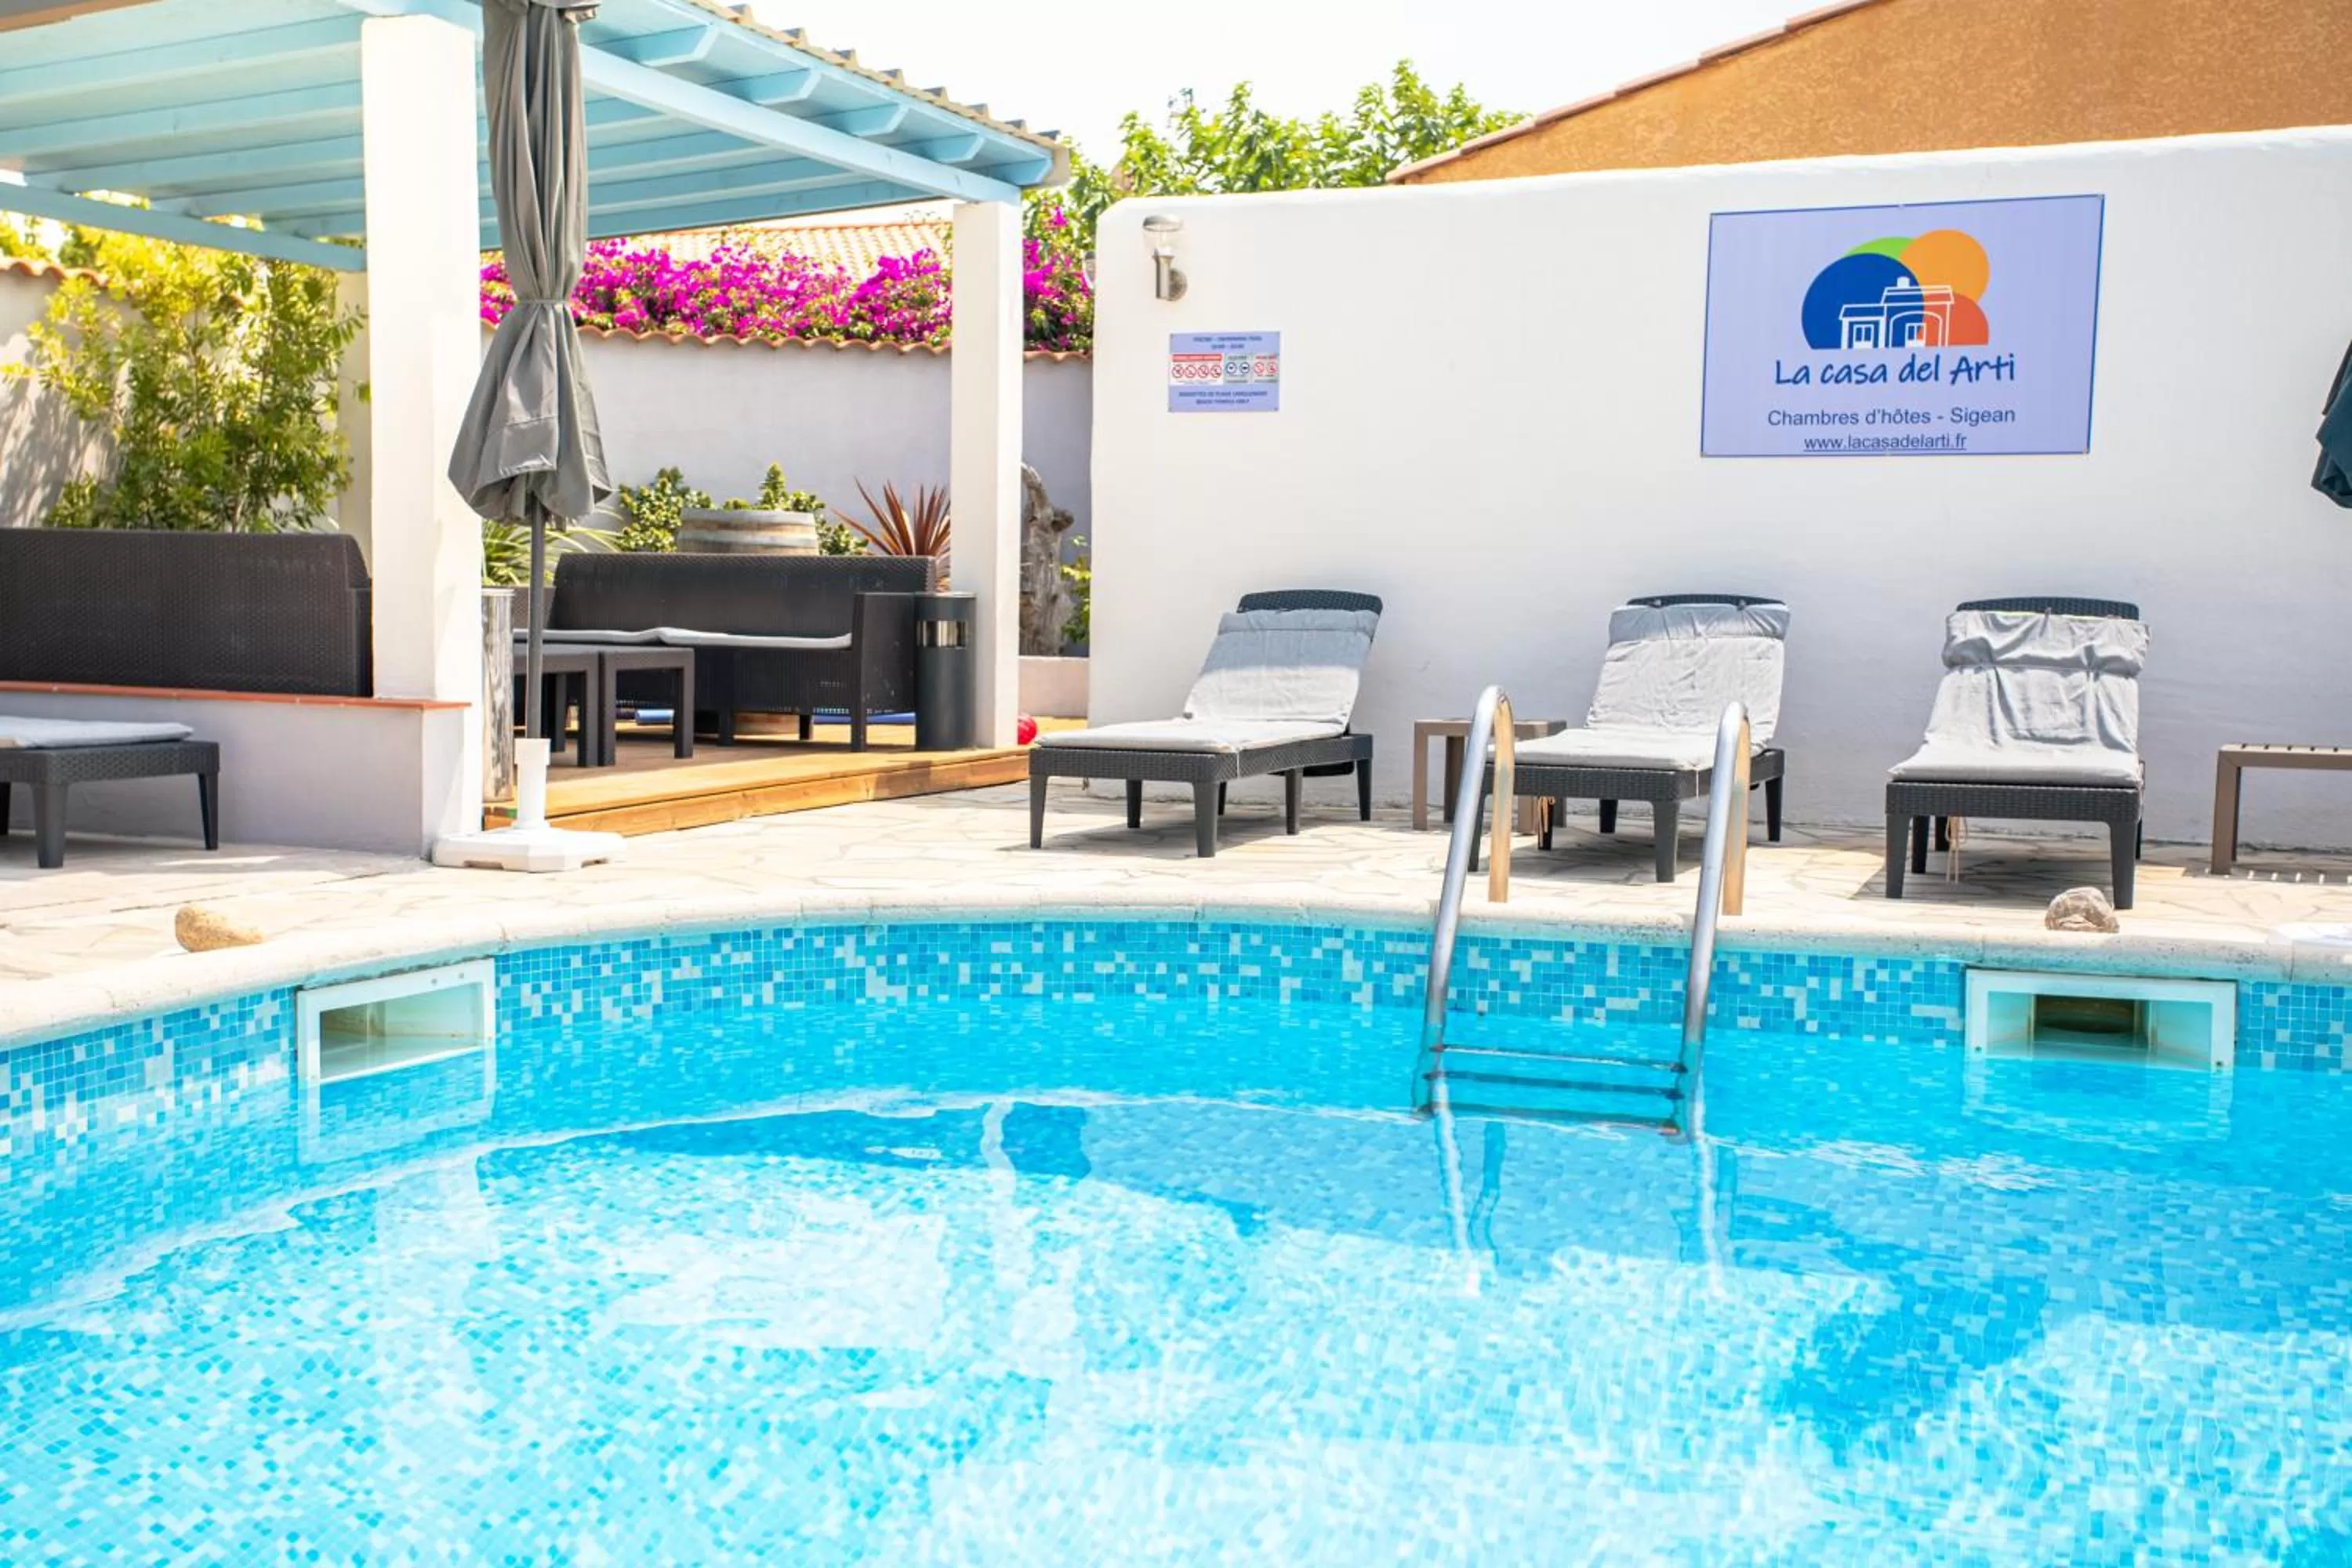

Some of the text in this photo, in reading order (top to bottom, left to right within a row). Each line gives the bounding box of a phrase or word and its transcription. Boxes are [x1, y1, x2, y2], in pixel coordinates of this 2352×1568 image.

[1775, 353, 2016, 385] La casa del Arti
[1767, 409, 1859, 426] Chambres
[1865, 408, 1931, 425] d'hôtes
[1950, 406, 2016, 427] Sigean
[1803, 433, 1967, 451] www.lacasadelarti.fr
